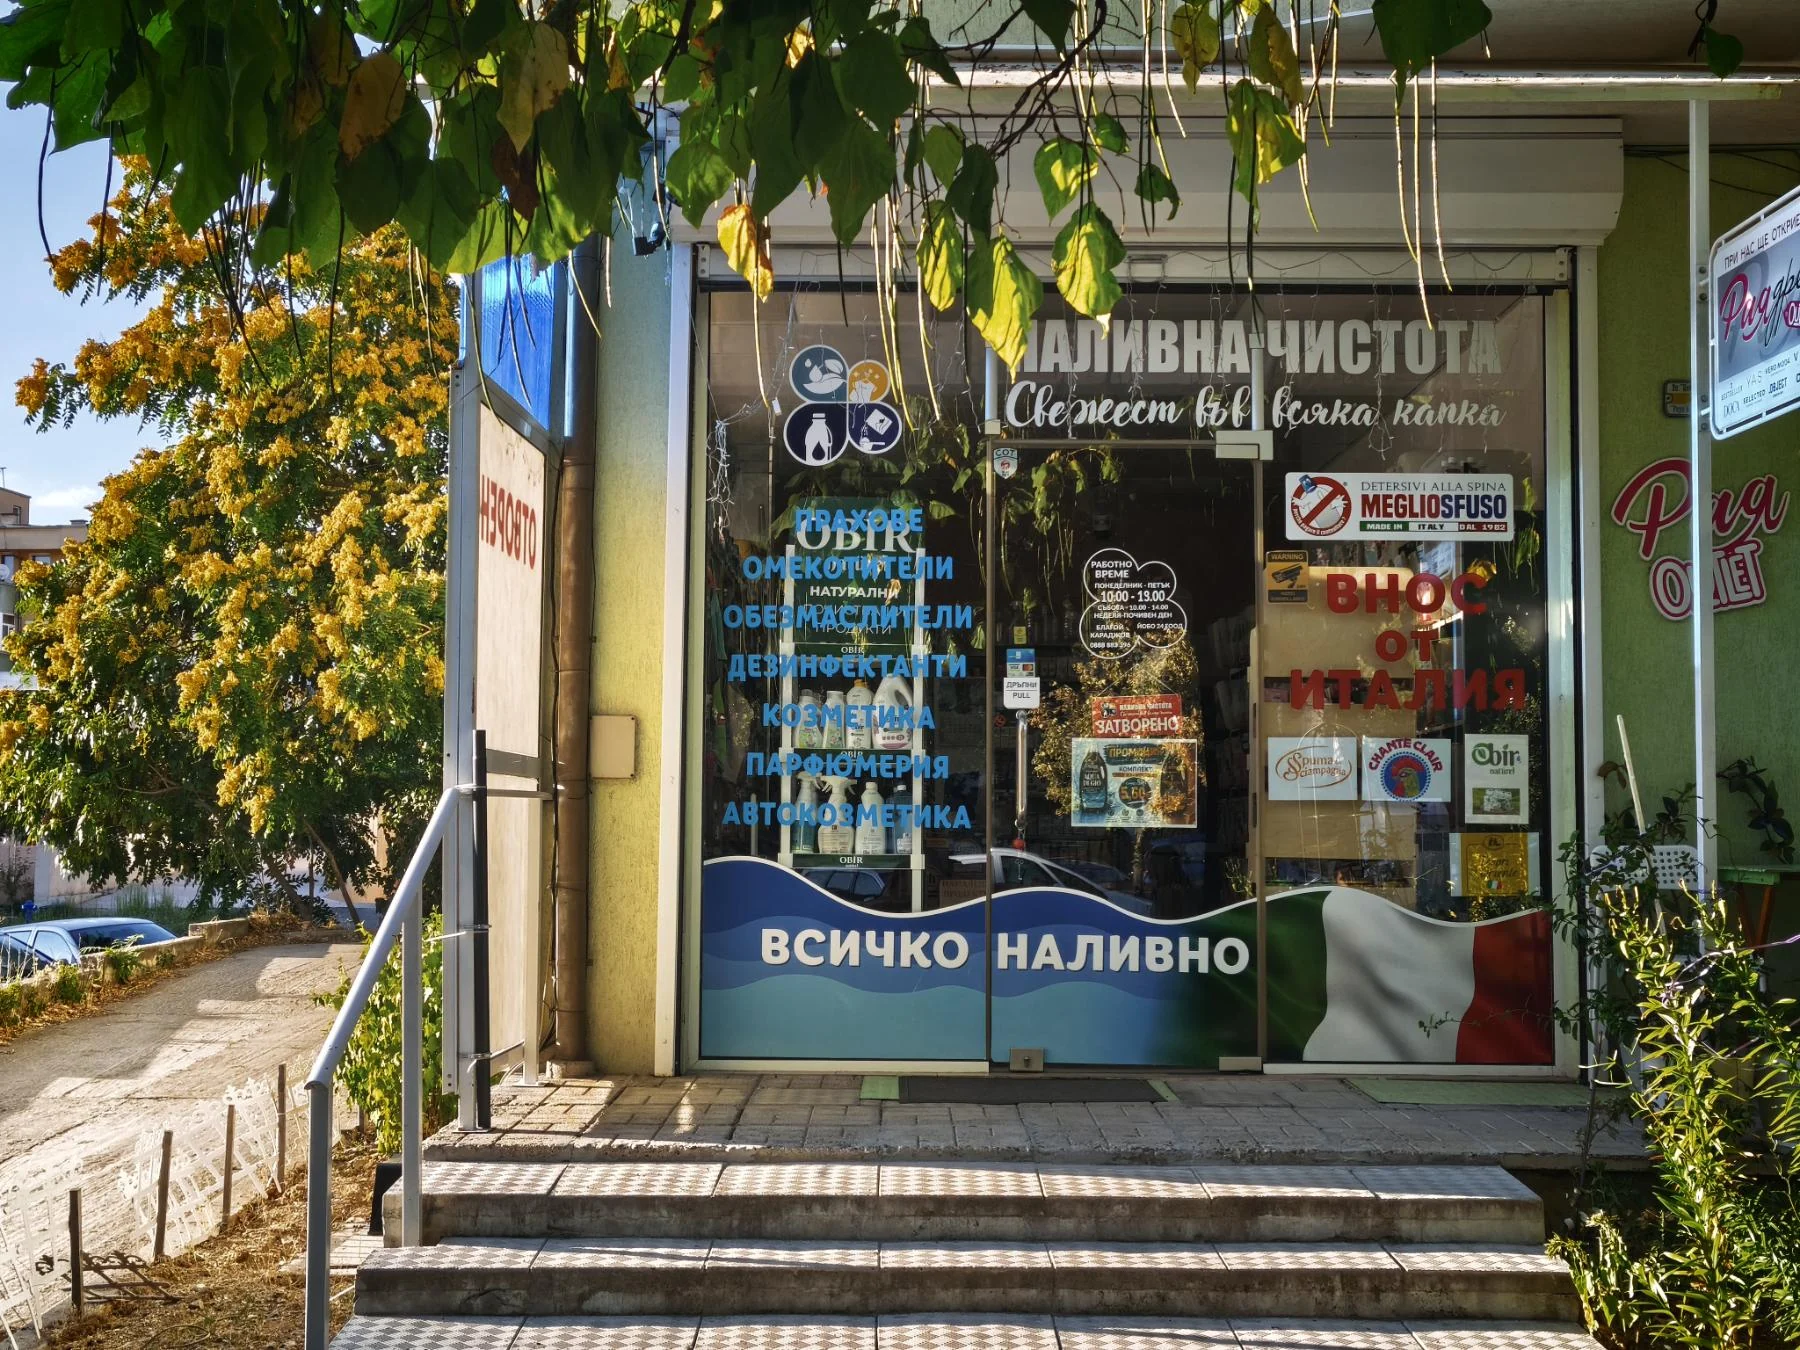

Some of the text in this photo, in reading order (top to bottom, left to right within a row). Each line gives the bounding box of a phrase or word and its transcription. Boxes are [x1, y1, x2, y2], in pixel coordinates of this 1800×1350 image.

[1723, 253, 1738, 271] ПРИ
[1740, 241, 1755, 260] НАС
[1757, 233, 1769, 250] ЩЕ
[1267, 319, 1503, 374] ЧИСТОТА
[1005, 380, 1507, 429] Свежест във всяка капка
[1361, 481, 1507, 492] DETERSIVI ALLA SPINA
[1360, 493, 1507, 519] MEGLIOSFUSO
[795, 507, 923, 533] ПРАХОВЕ
[1418, 523, 1444, 531] ITALY
[741, 555, 954, 582] ОМЕКОТИТЕЛИ
[1091, 560, 1133, 569] РАБОТНО
[1095, 569, 1129, 579] ВРЕМЕ
[809, 585, 899, 600] НАТУРАЛНИ
[1094, 582, 1143, 590] ПОНЕДЕЛНИК
[1326, 572, 1488, 615] ВНОС
[1650, 539, 1767, 621] OTLET
[723, 603, 973, 630] ОБЕЗМАСЛИТЕЛИ
[1095, 623, 1124, 631] БЛАГОЙ
[727, 653, 967, 682] ДЕЗИНФЕКТАНТИ
[1005, 681, 1037, 689] ДРЪПНИ
[1012, 691, 1031, 699] PULL
[1289, 669, 1526, 711] ИТАЛИЯ
[762, 702, 936, 730] КОЗМЕТИКА
[1096, 714, 1179, 734] ЗАТВОРЕНО
[745, 751, 950, 780] ПАРФЮМЕРИЯ
[1368, 738, 1443, 773] CHANTE CLAIR
[721, 800, 972, 830] АВТОКОЗМЕТИКА
[760, 927, 1250, 977] ВСИЧКО НАЛИВНО
